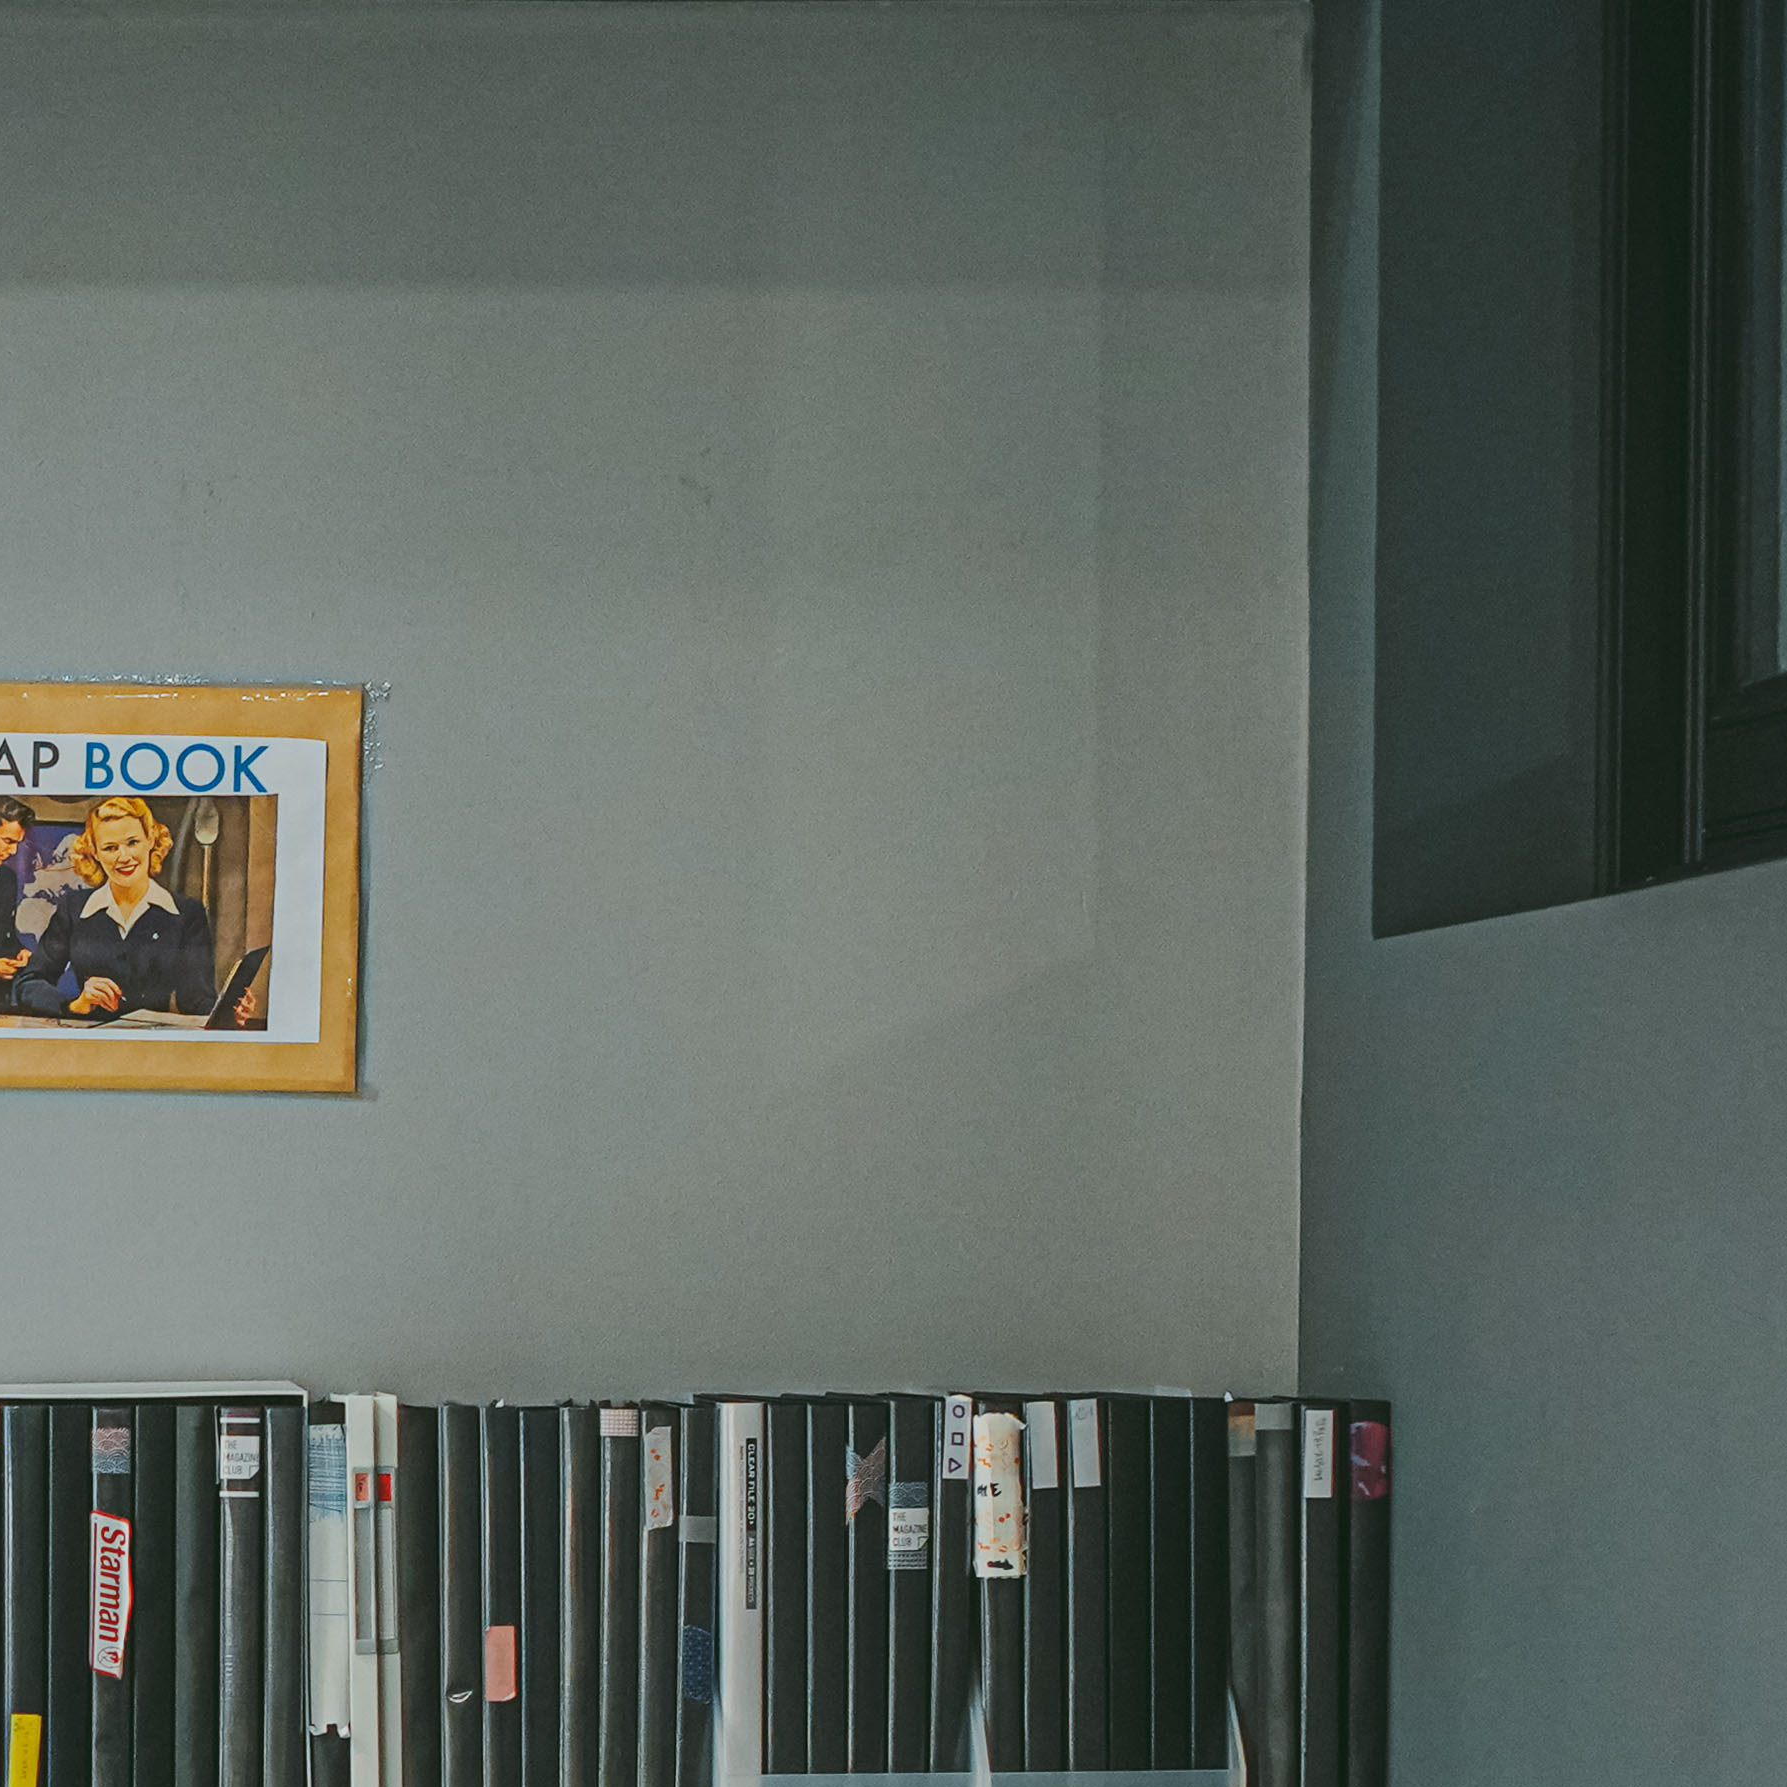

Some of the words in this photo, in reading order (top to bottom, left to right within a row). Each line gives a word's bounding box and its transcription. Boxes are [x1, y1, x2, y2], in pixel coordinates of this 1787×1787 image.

[84, 742, 269, 794] BOOK
[747, 1443, 756, 1478] CLEAR
[99, 1525, 127, 1642] Starman
